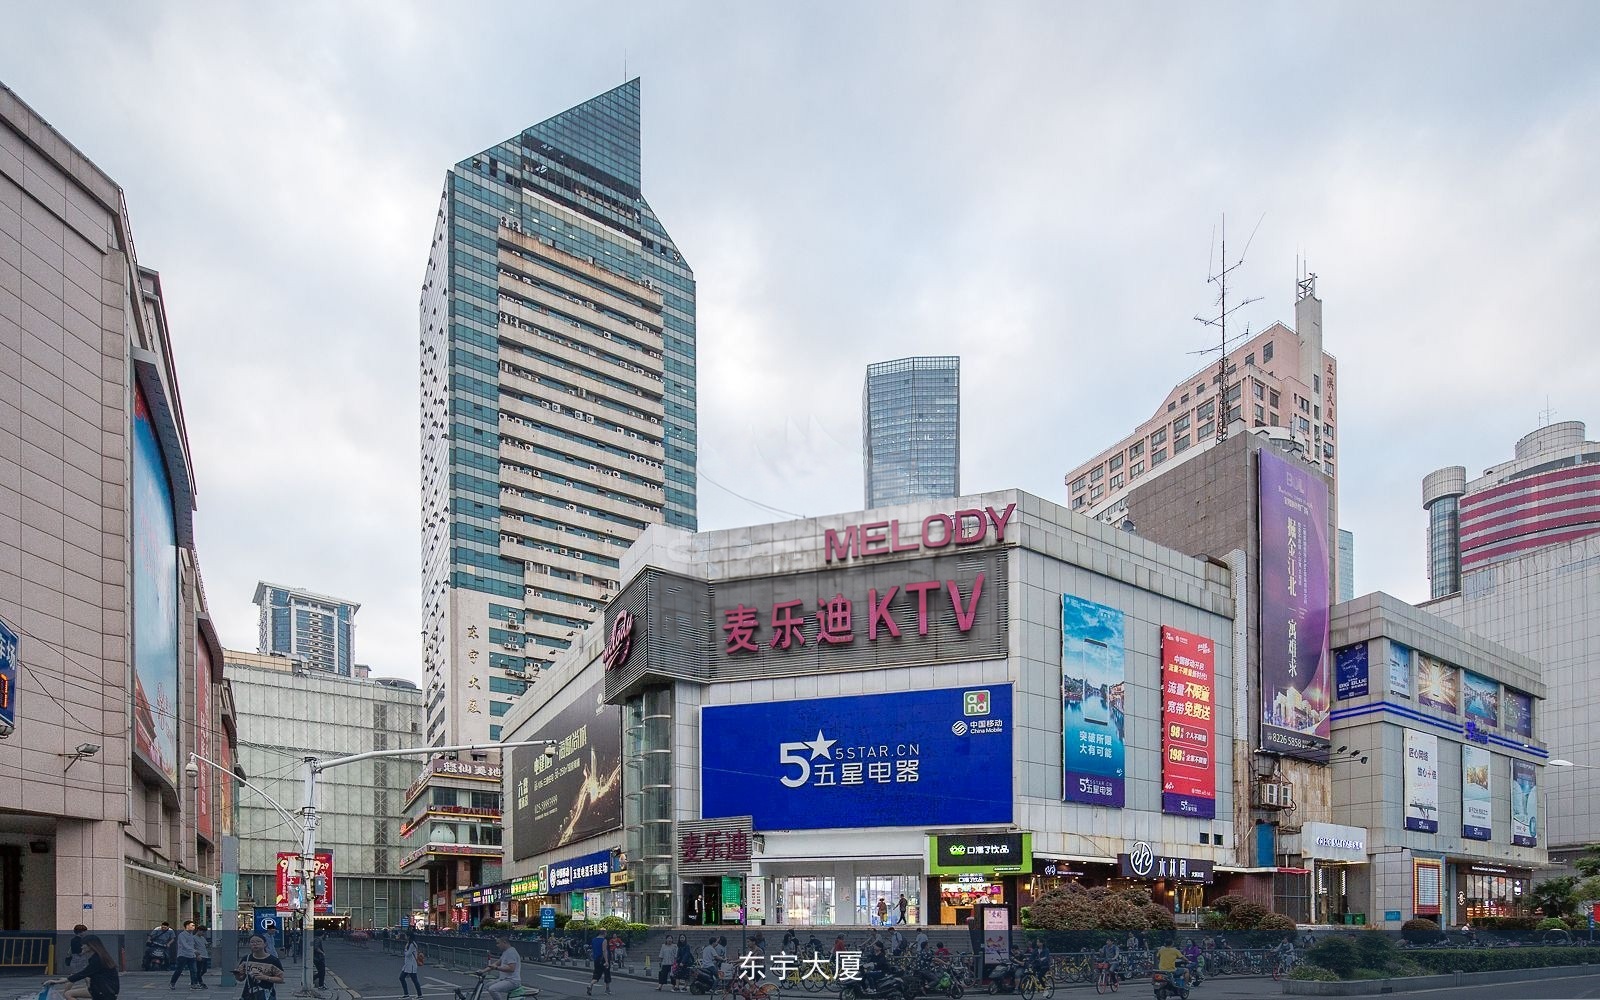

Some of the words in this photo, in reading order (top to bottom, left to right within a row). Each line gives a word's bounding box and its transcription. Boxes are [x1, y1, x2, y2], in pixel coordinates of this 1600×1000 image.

[825, 503, 1017, 563] MELODY
[970, 719, 1003, 729] 中国移动
[1170, 725, 1181, 738] 98
[1272, 732, 1288, 745] 8226
[835, 744, 920, 760] 5STAR.CN
[1079, 743, 1112, 759] 大有可能
[1169, 747, 1183, 761] 198
[813, 759, 920, 787] 五星电器
[681, 828, 752, 863] 麦乐迪
